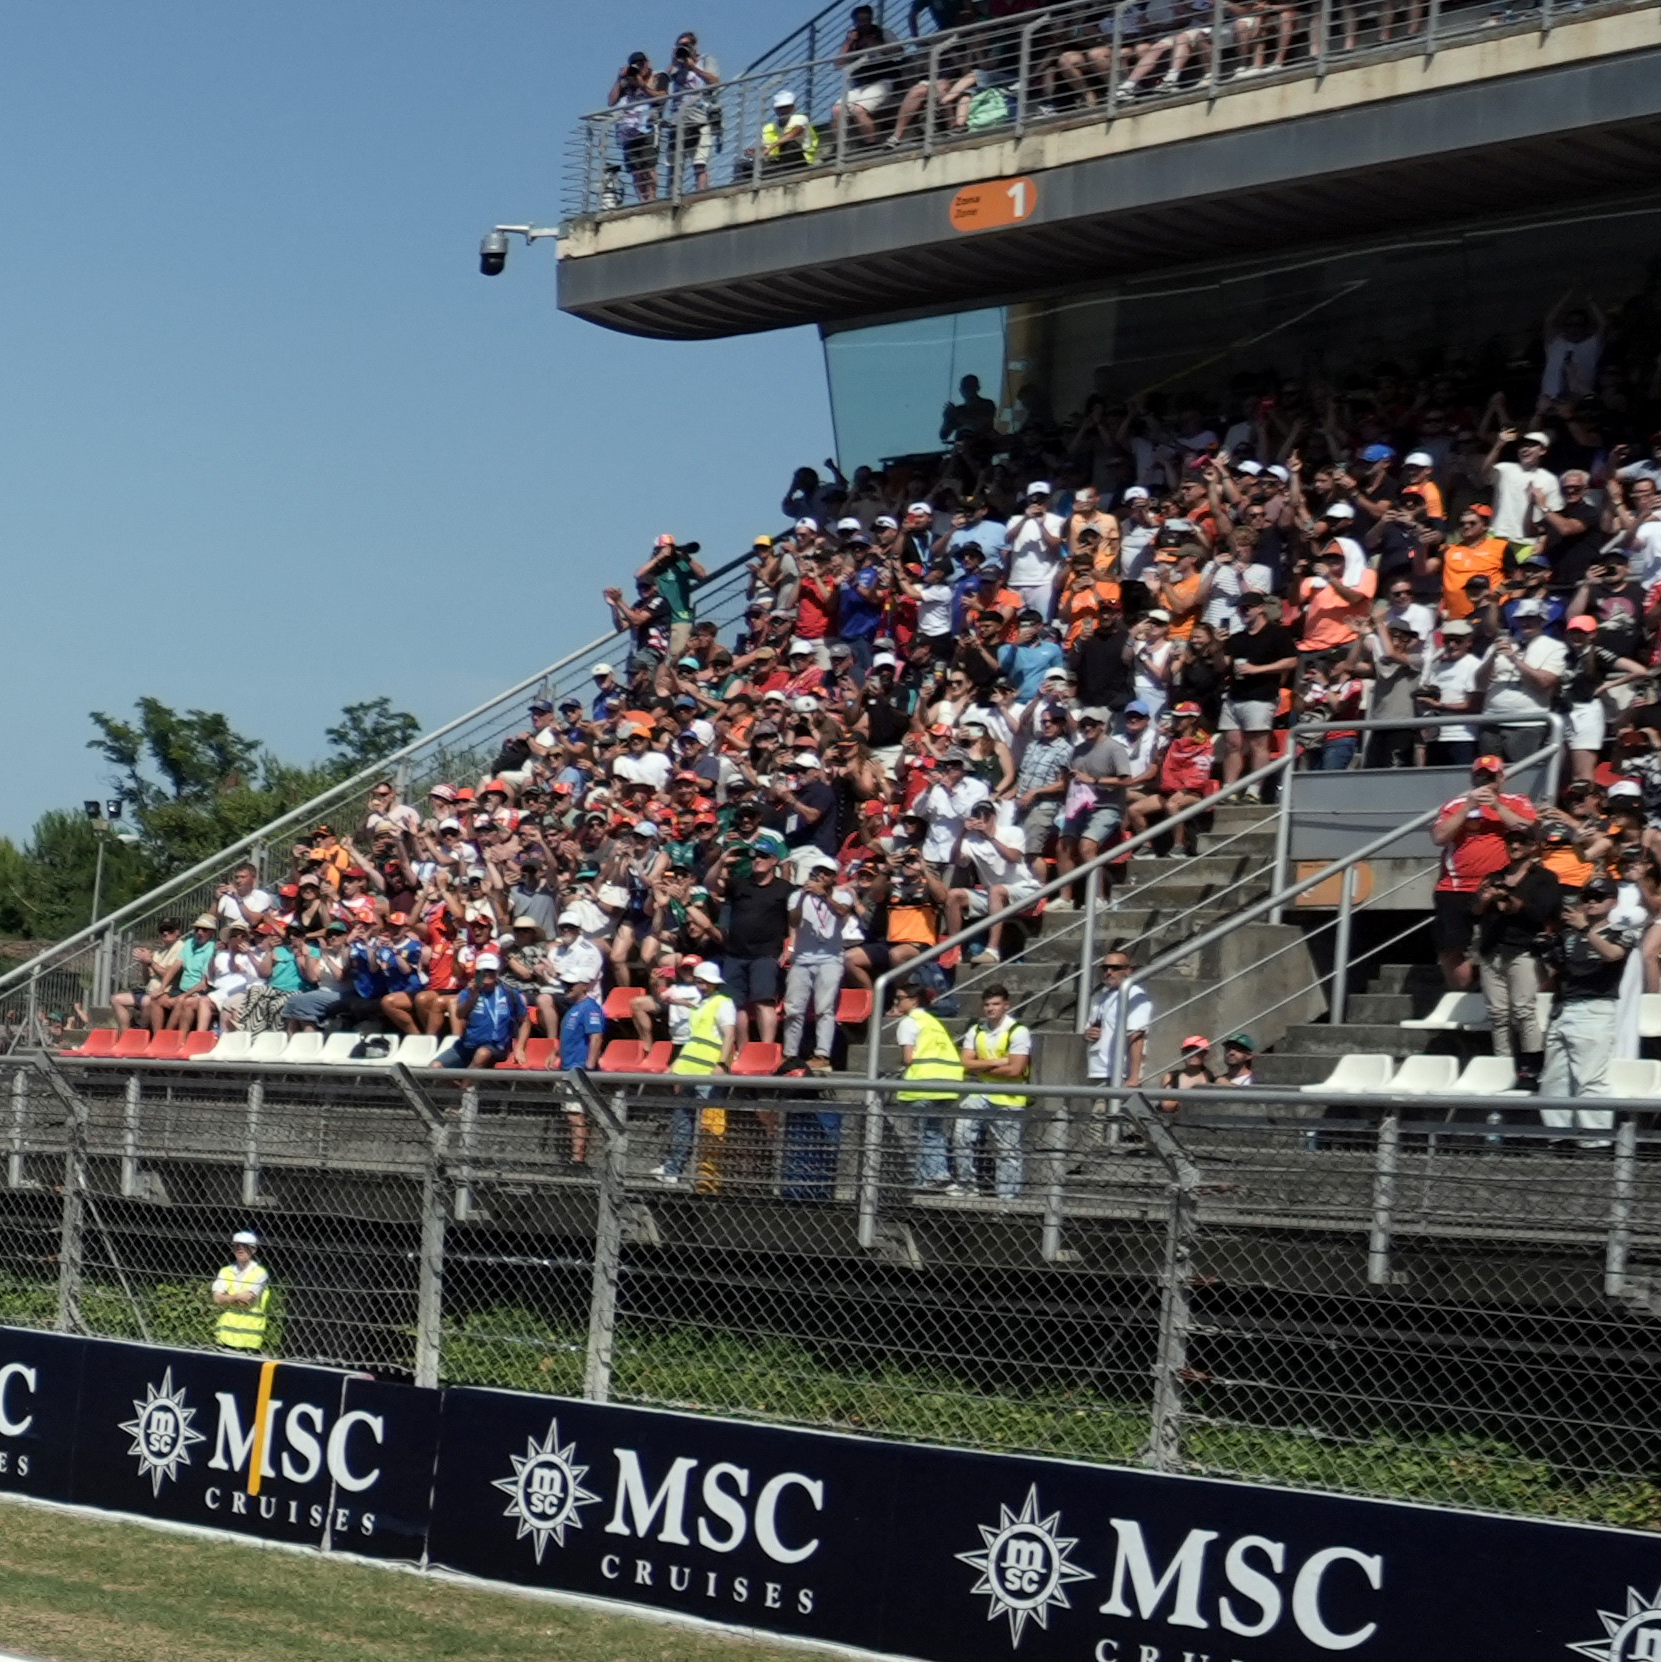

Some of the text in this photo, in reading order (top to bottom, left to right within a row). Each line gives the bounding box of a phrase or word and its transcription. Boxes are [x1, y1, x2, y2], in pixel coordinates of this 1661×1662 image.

[1007, 181, 1025, 217] 1
[207, 1391, 384, 1492] MSC
[204, 1486, 376, 1536] CRUISES
[604, 1447, 824, 1564] MSC
[601, 1554, 814, 1615] CRUISES
[1098, 1517, 1384, 1652] MSC
